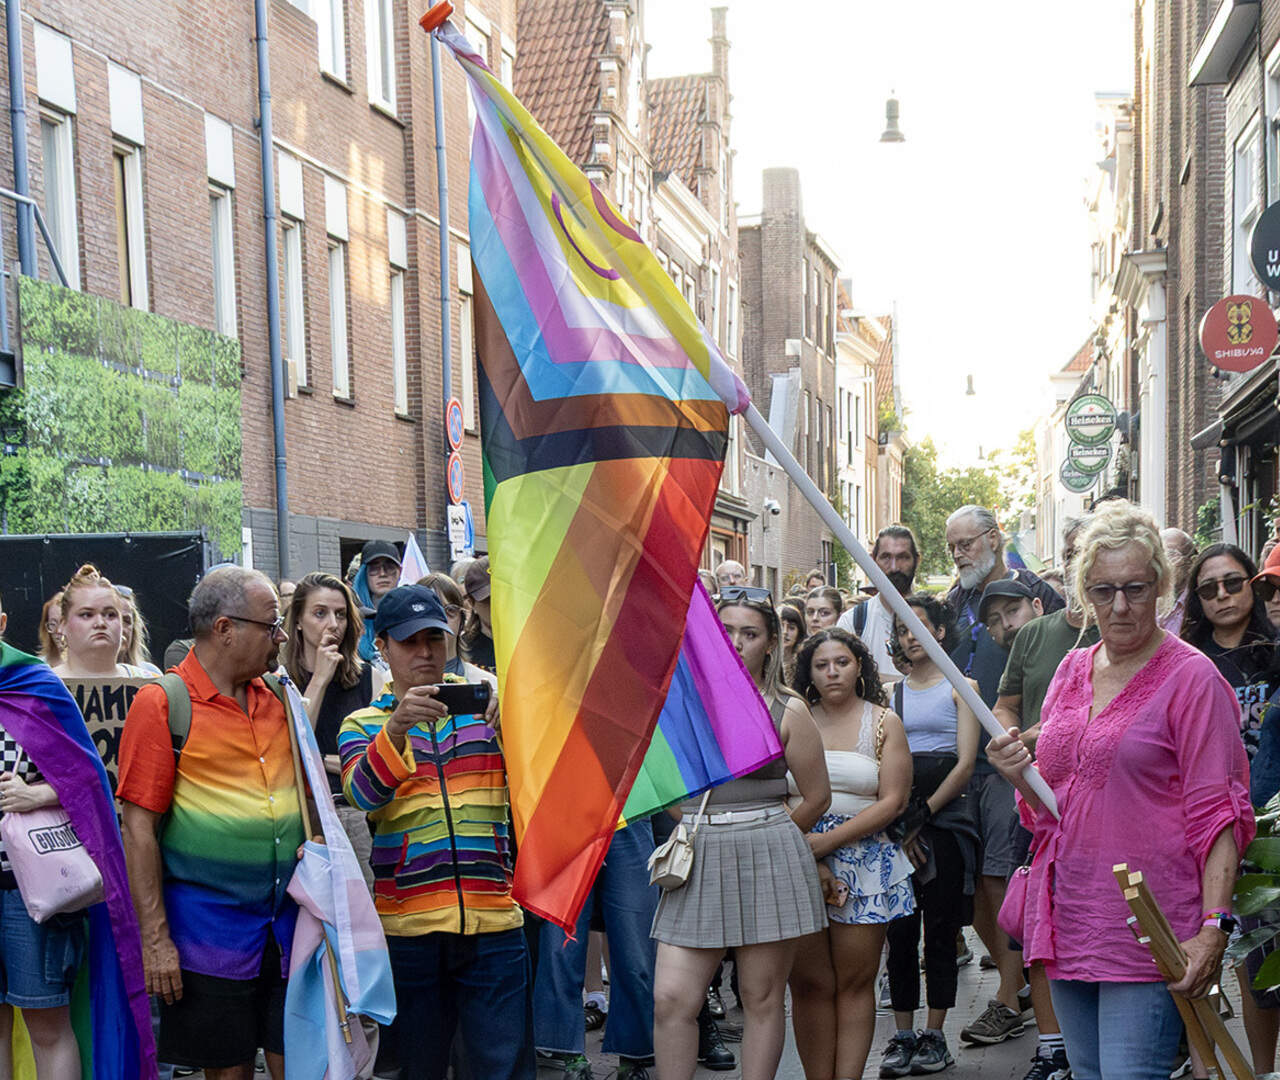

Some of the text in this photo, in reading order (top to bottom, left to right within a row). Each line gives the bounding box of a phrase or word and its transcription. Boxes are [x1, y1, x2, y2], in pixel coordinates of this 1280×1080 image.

[1215, 347, 1264, 358] SHIBUYA
[1071, 414, 1112, 425] Heineken
[35, 824, 79, 850] episod
